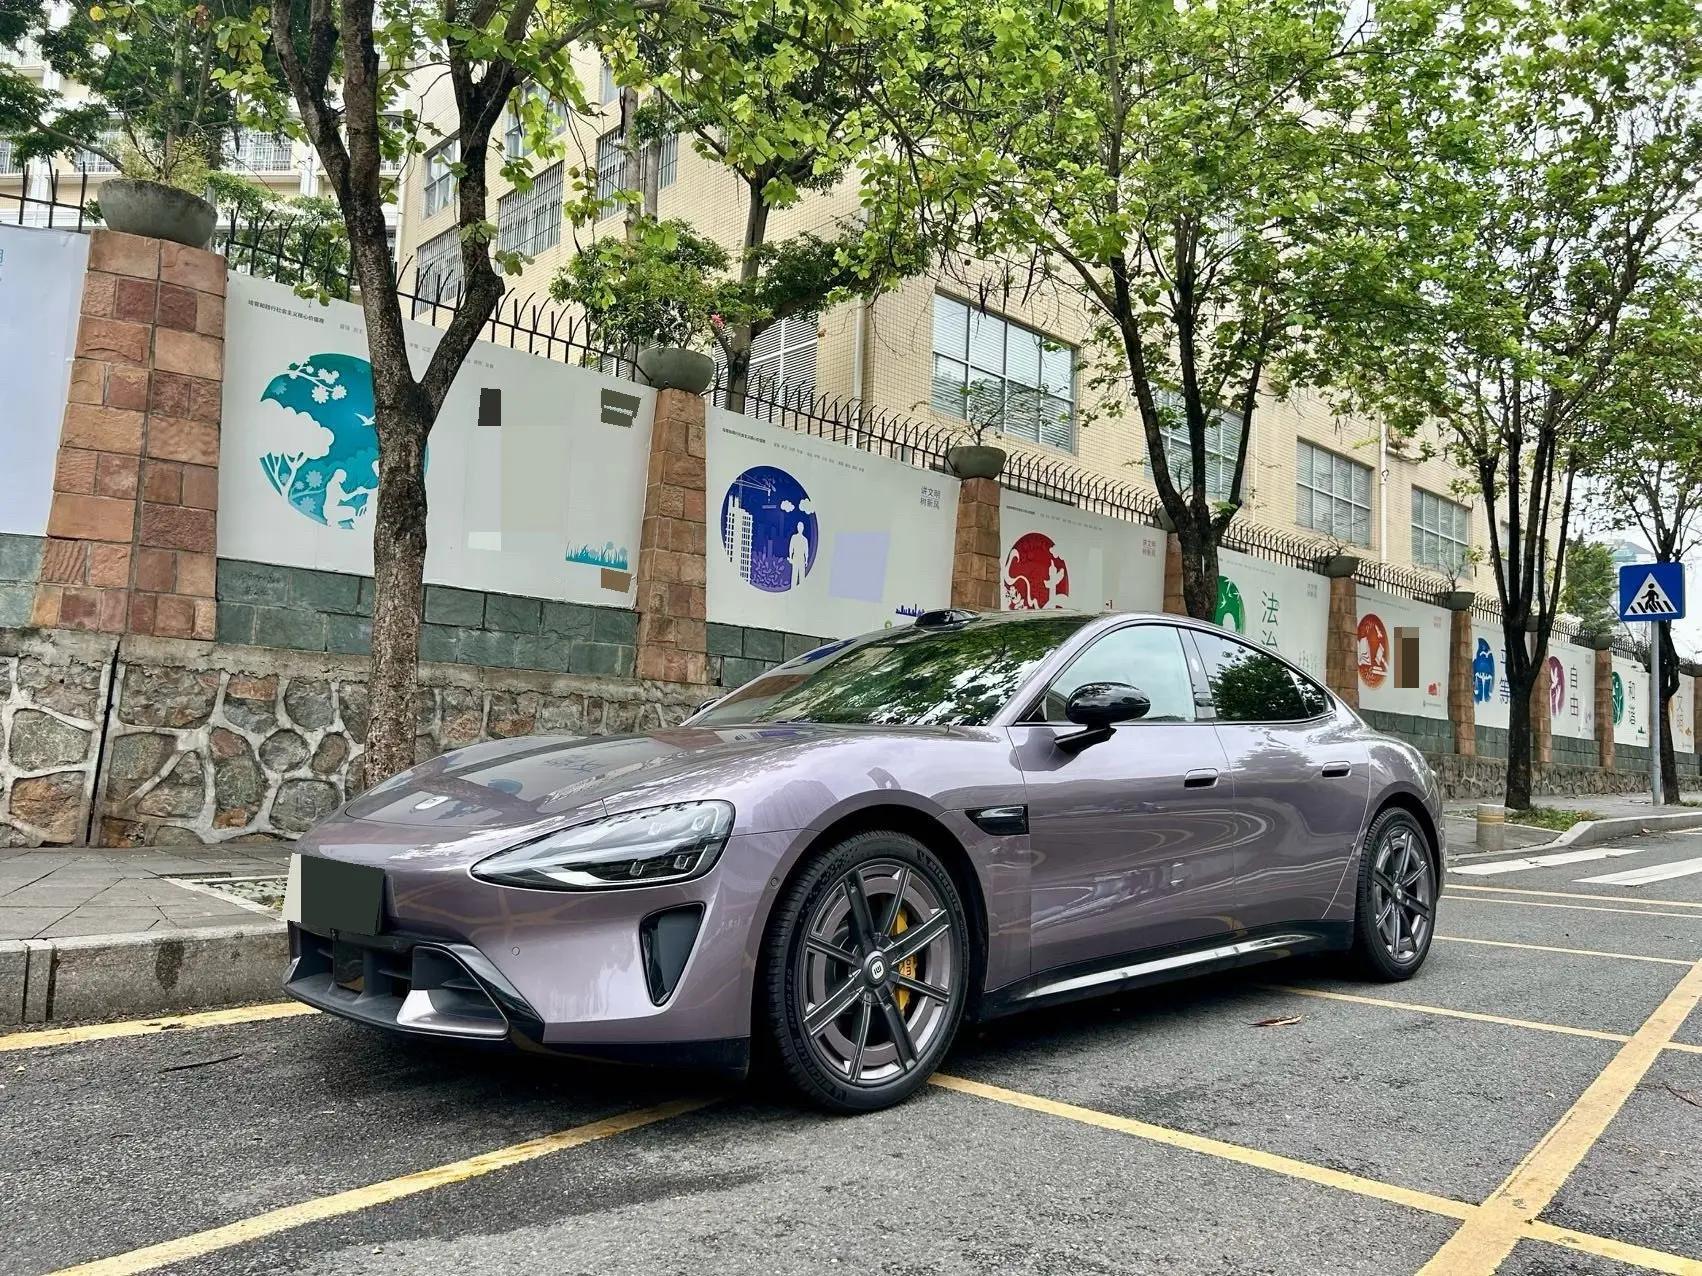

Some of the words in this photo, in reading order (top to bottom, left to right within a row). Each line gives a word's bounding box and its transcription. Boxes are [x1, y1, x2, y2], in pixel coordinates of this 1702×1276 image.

[921, 486, 941, 499] 讲文明
[1569, 664, 1579, 717] 自由
